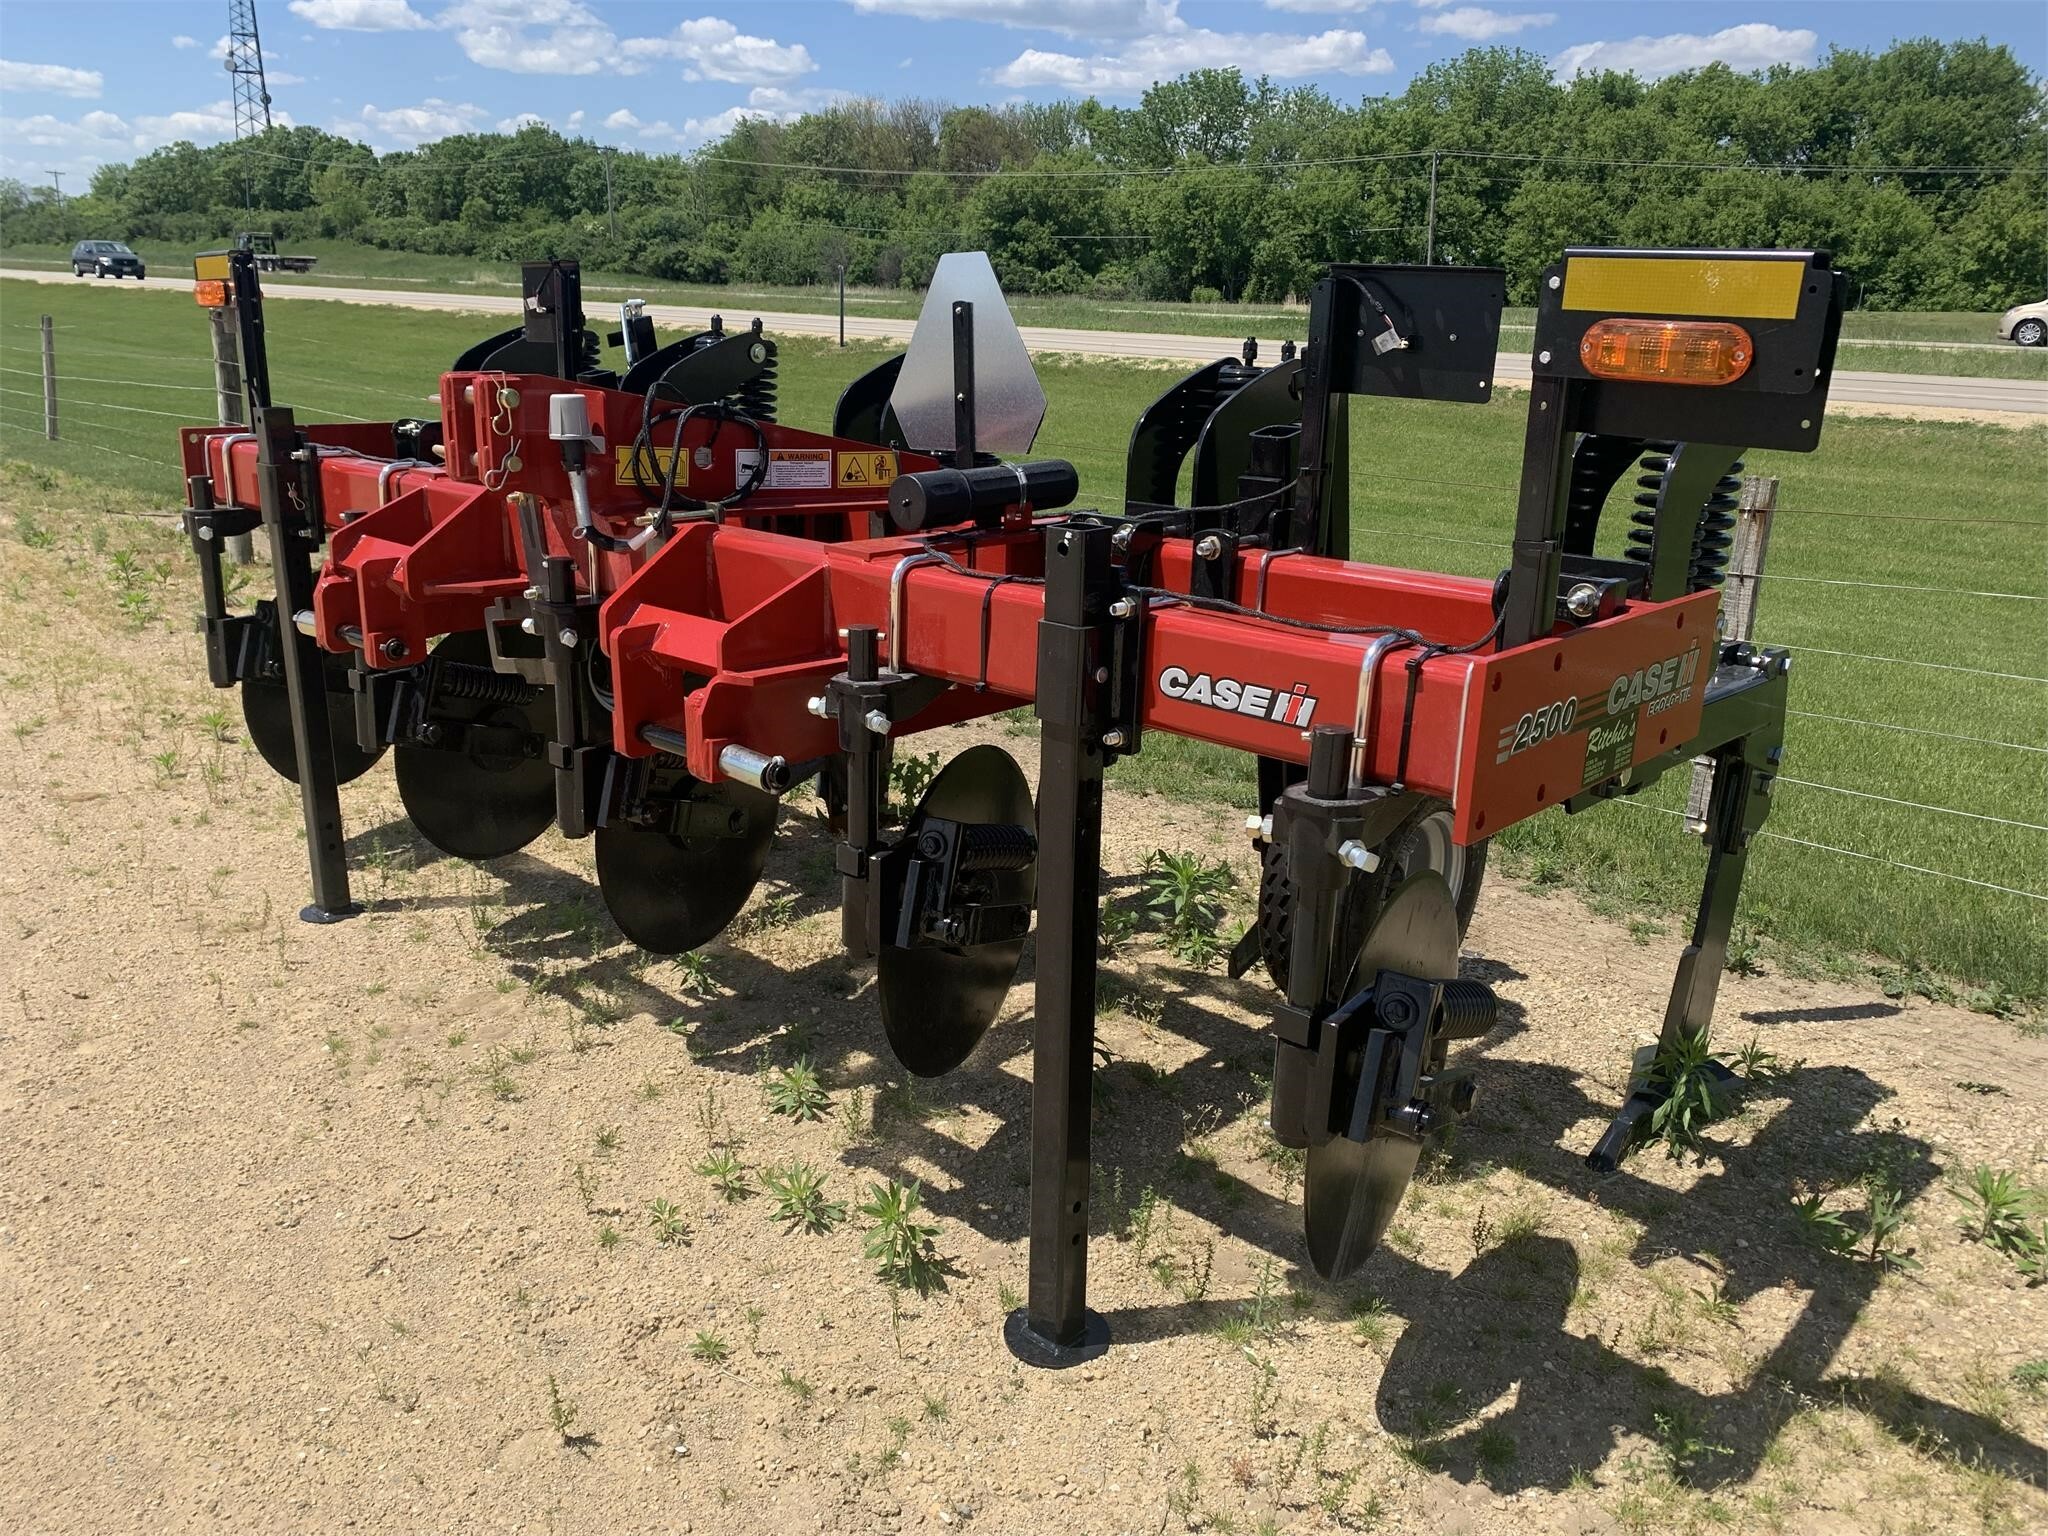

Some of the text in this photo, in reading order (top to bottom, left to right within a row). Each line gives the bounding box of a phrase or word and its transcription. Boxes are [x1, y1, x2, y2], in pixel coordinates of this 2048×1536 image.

[1159, 667, 1273, 717] CASE
[1607, 657, 1679, 715] CASE
[1510, 696, 1578, 756] 2500
[1586, 712, 1637, 757] Ritchie's
